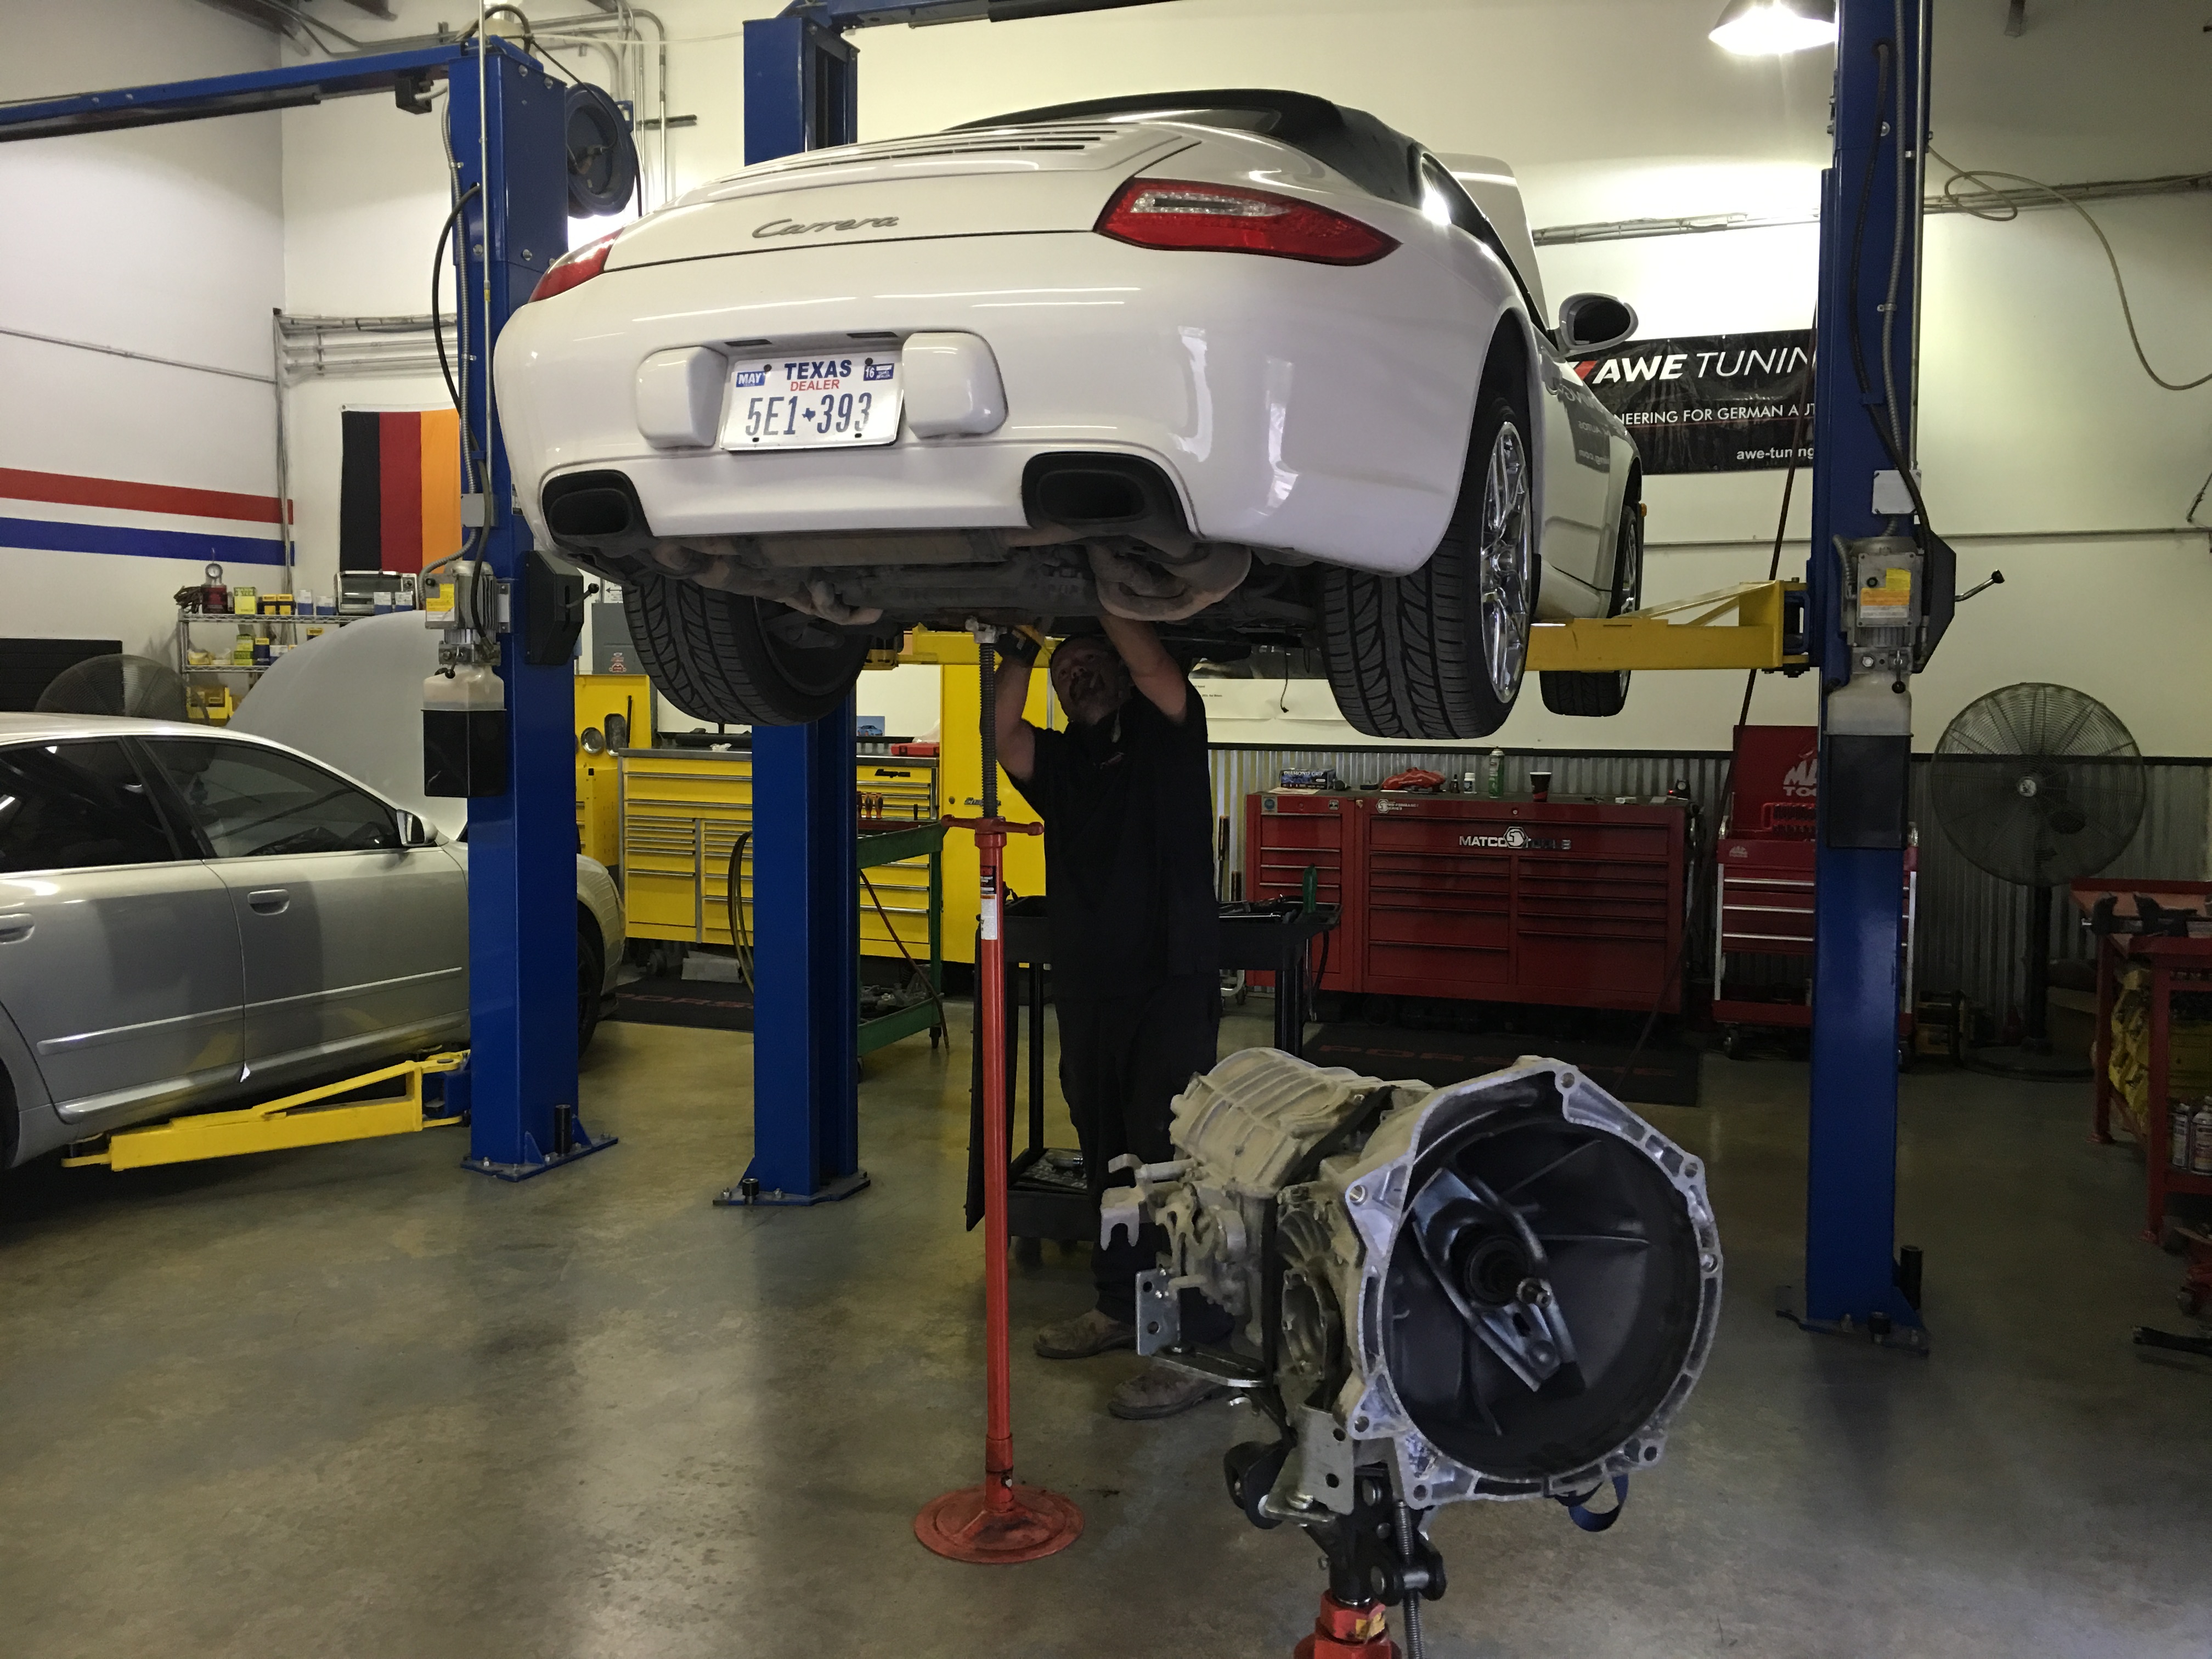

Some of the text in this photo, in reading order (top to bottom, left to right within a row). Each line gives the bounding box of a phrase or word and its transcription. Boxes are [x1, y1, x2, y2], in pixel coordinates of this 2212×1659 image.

[752, 216, 899, 238] Carrera
[784, 359, 853, 380] TEXAS
[866, 367, 875, 378] 16
[1592, 354, 1688, 384] AWE
[738, 373, 761, 384] MAY
[790, 379, 840, 392] DEALER
[1683, 408, 1713, 422] FOR
[1717, 405, 1783, 420] GERMAN
[1736, 447, 1815, 460] awe-tunng
[1459, 836, 1508, 848] MATCO
